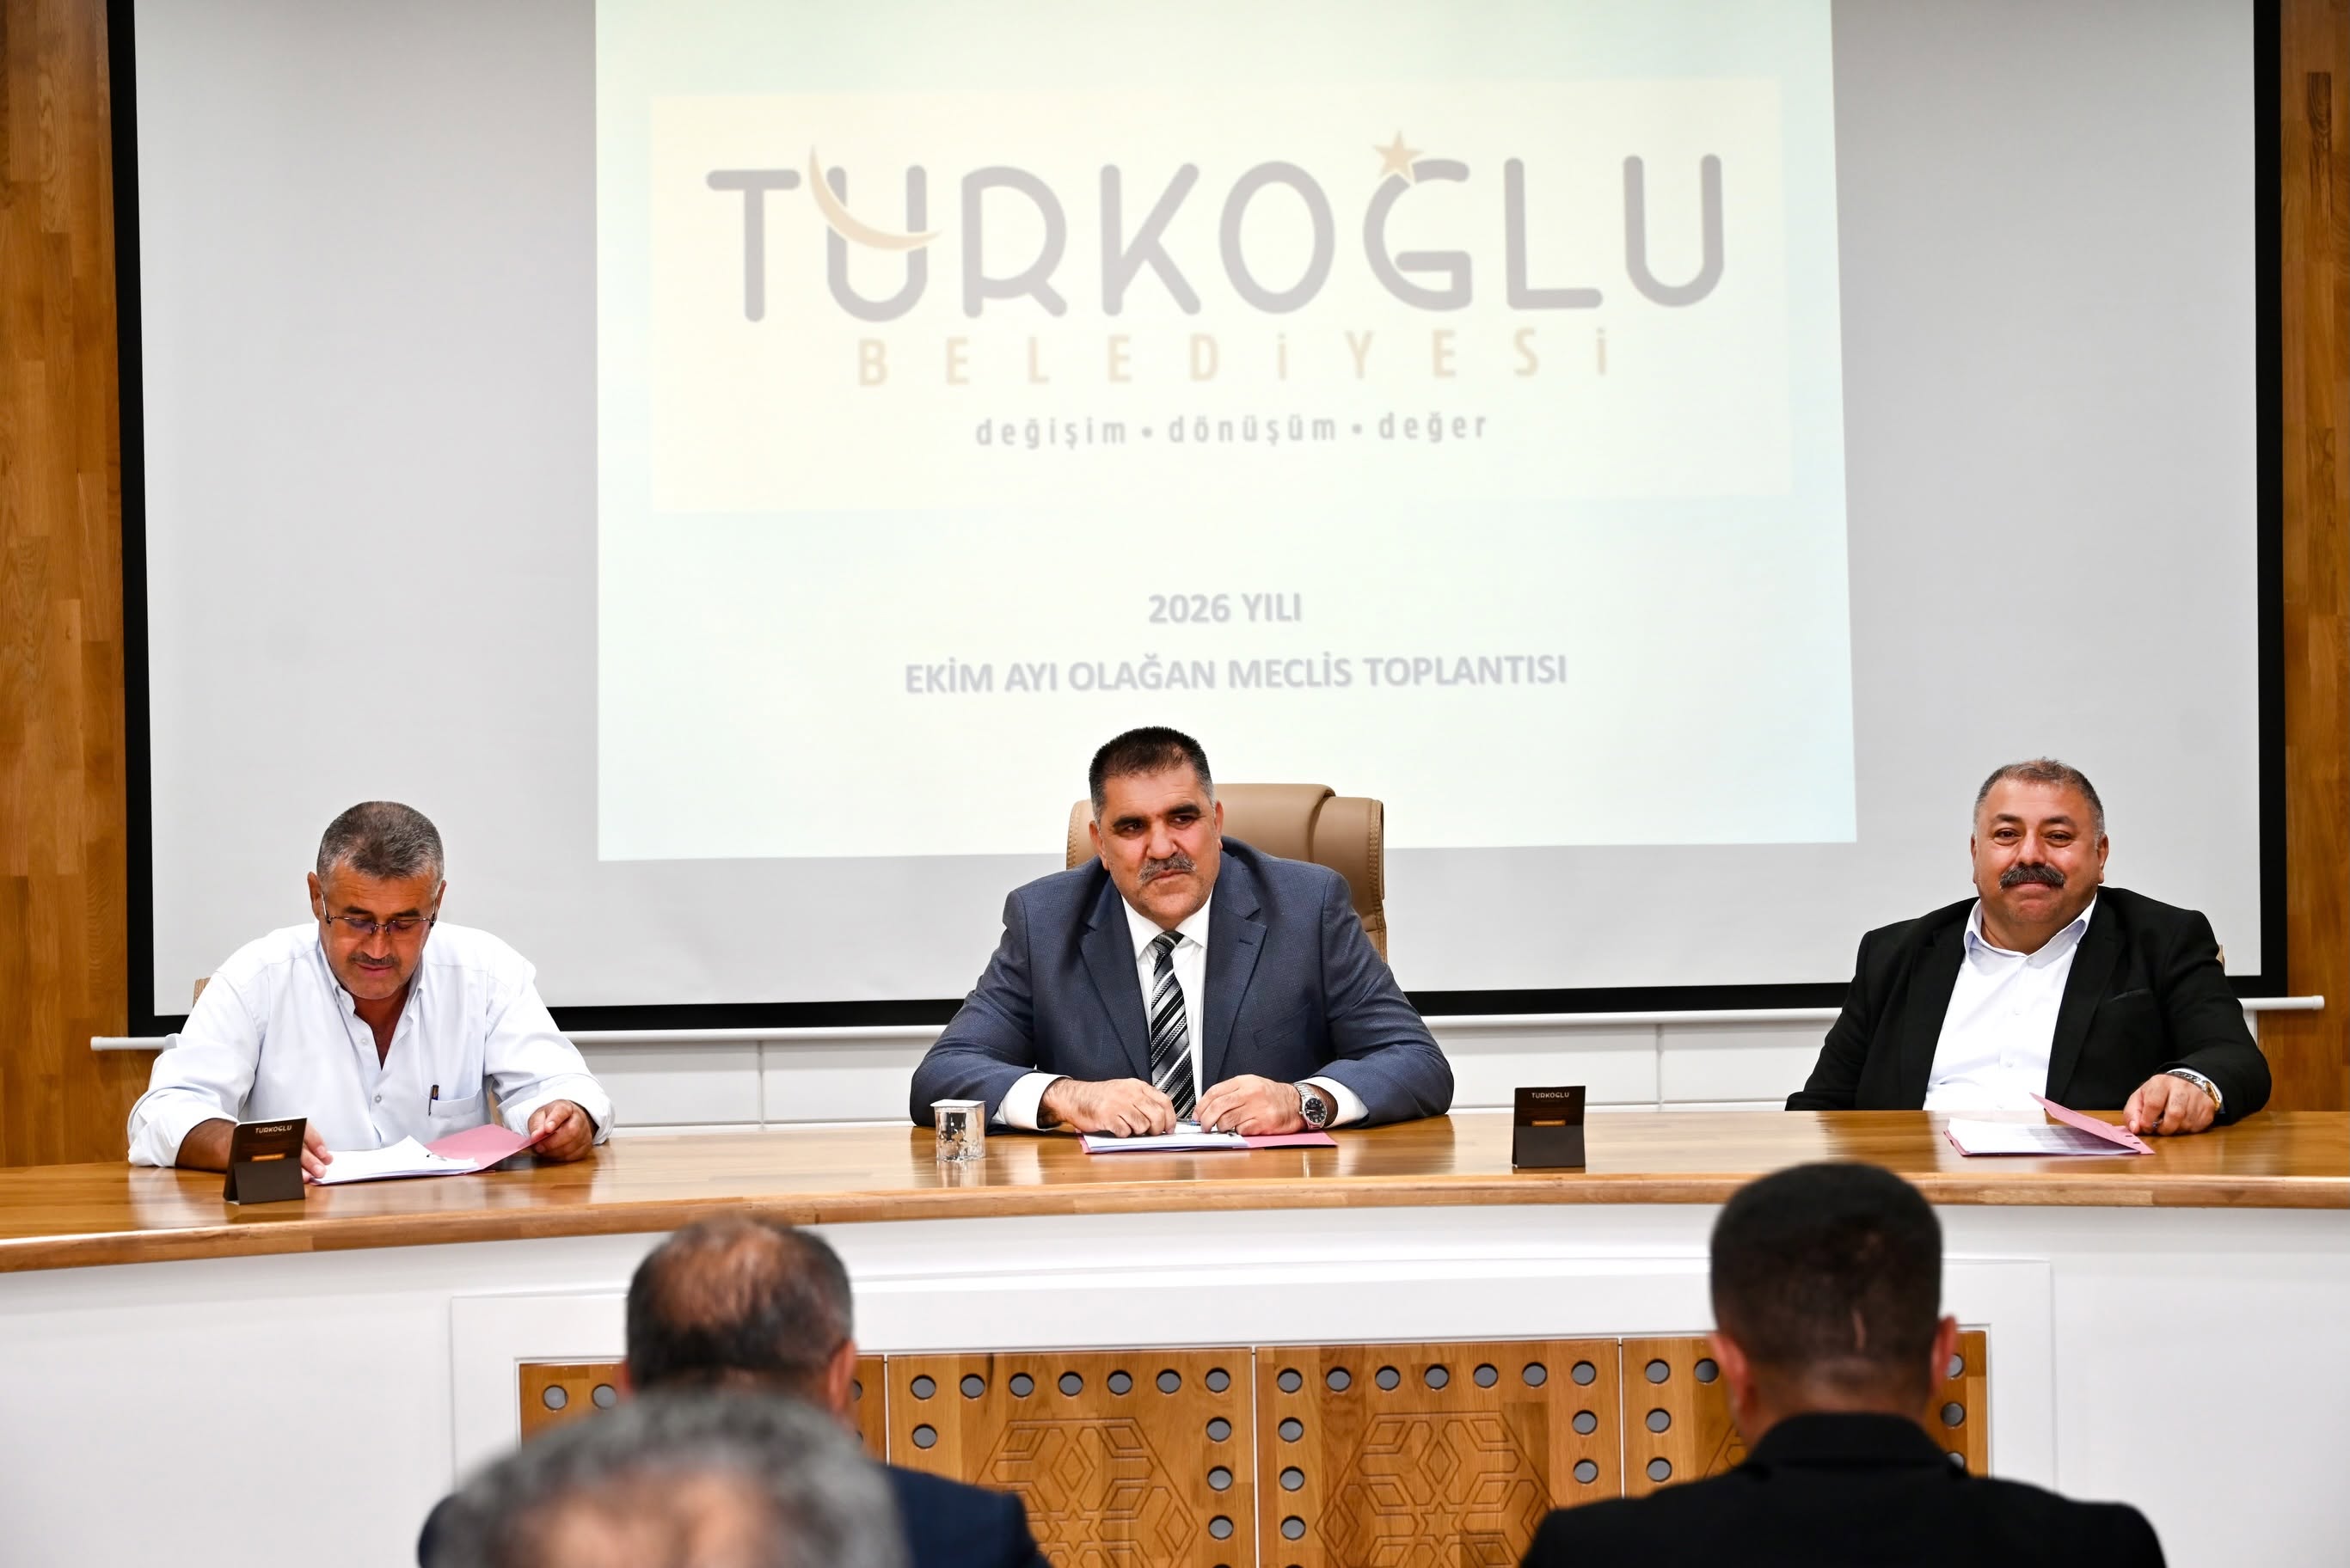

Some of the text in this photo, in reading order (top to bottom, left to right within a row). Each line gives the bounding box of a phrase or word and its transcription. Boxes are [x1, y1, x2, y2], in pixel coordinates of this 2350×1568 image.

[976, 412, 1488, 450] değişim dönüşüm değer
[1148, 592, 1302, 623] 2026 YILI
[905, 651, 1567, 694] EKİM AYI OLAĞAN MECLİS TOPLANTISI
